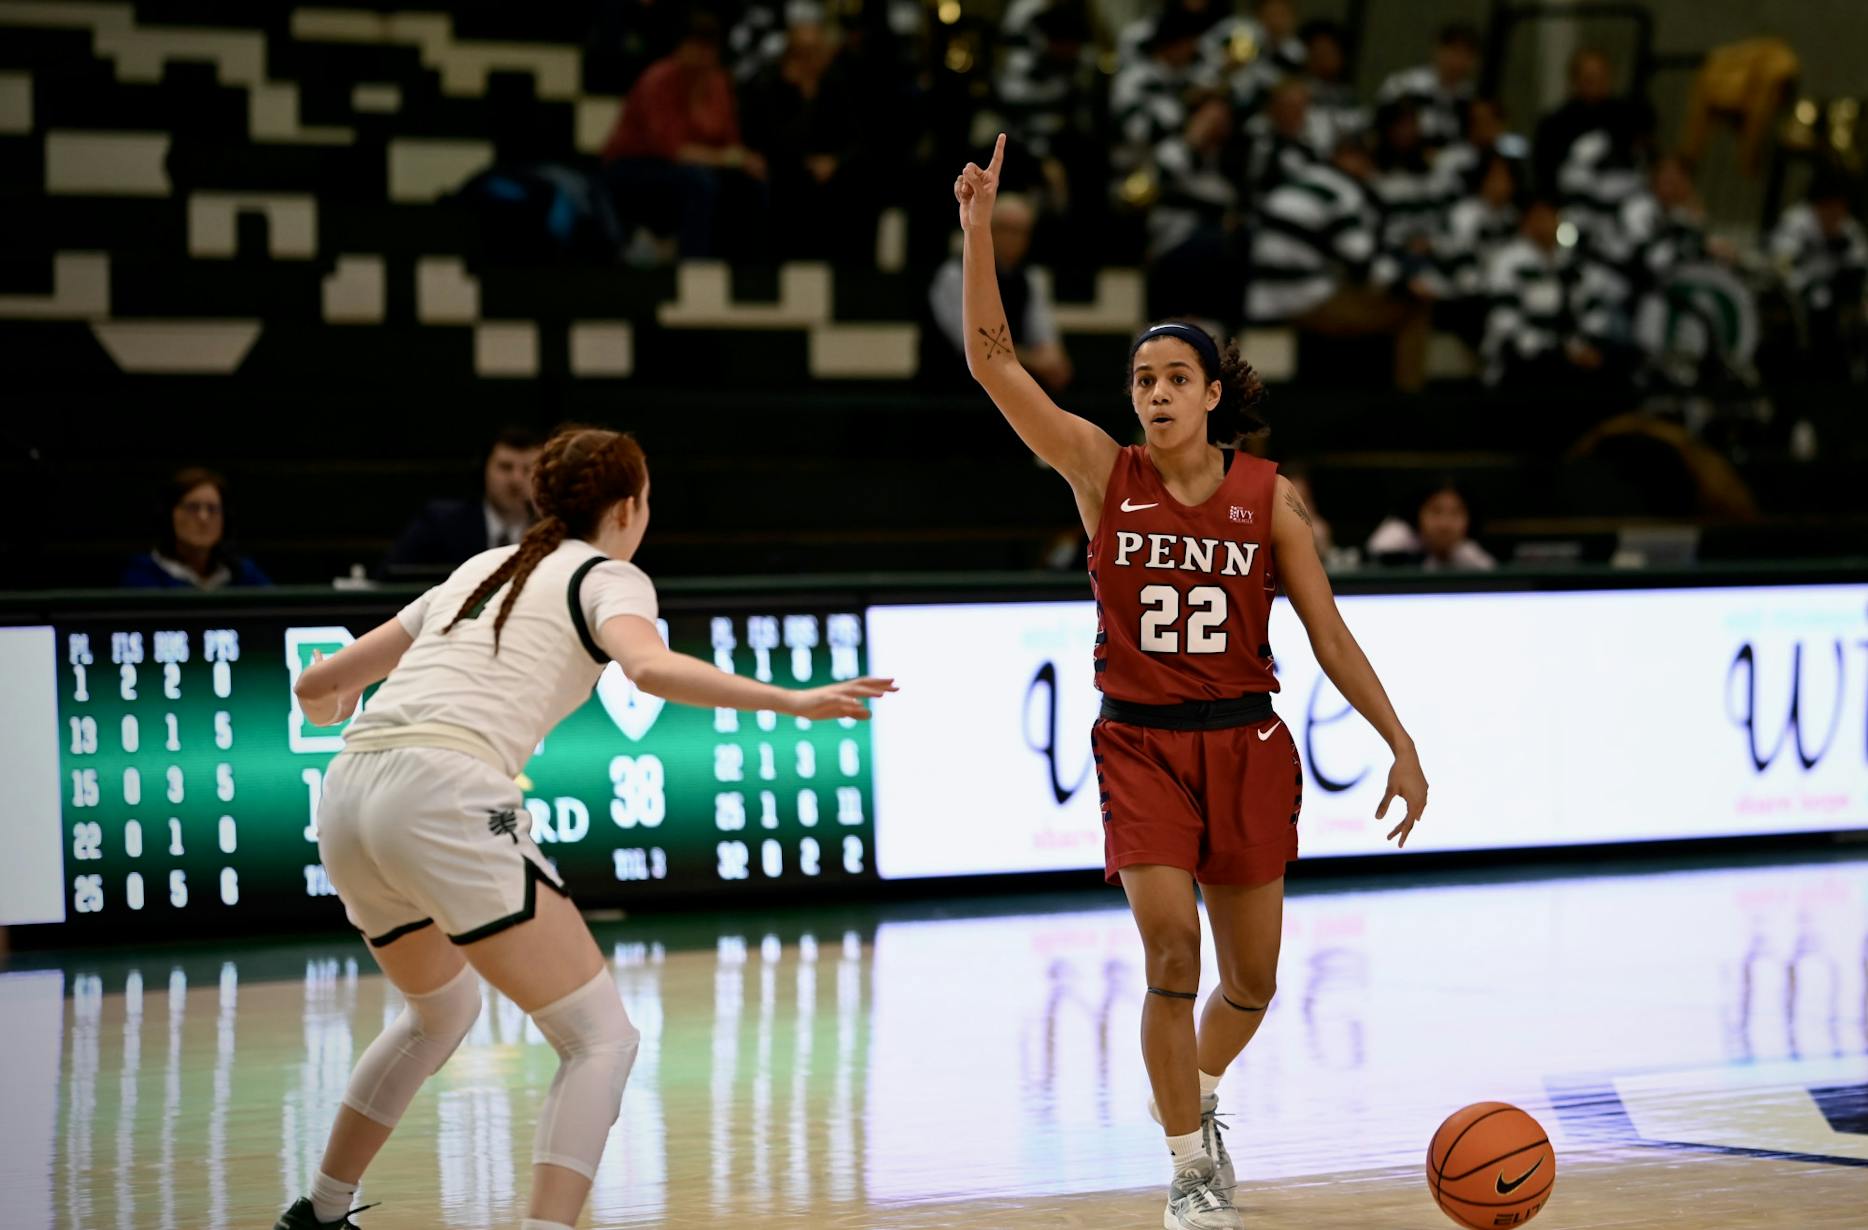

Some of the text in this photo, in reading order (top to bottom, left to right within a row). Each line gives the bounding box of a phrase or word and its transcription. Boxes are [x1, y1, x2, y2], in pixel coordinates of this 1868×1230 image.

[1235, 509, 1254, 519] IVY
[1114, 531, 1259, 576] PENN
[1138, 583, 1229, 655] 22
[74, 661, 231, 701] 1 2 2 0
[755, 648, 772, 682] 1
[69, 711, 233, 754] 13 0 1 5
[759, 742, 776, 780] 1
[72, 763, 234, 807] 15 0 3 5
[609, 755, 665, 828] 38
[760, 791, 778, 829] 1
[73, 815, 237, 860] 22 0 1 0
[761, 839, 783, 878] 0
[800, 837, 820, 876] 2
[843, 835, 864, 874] 2
[74, 874, 104, 913] 25
[127, 871, 145, 910] 0
[169, 869, 188, 908] 5
